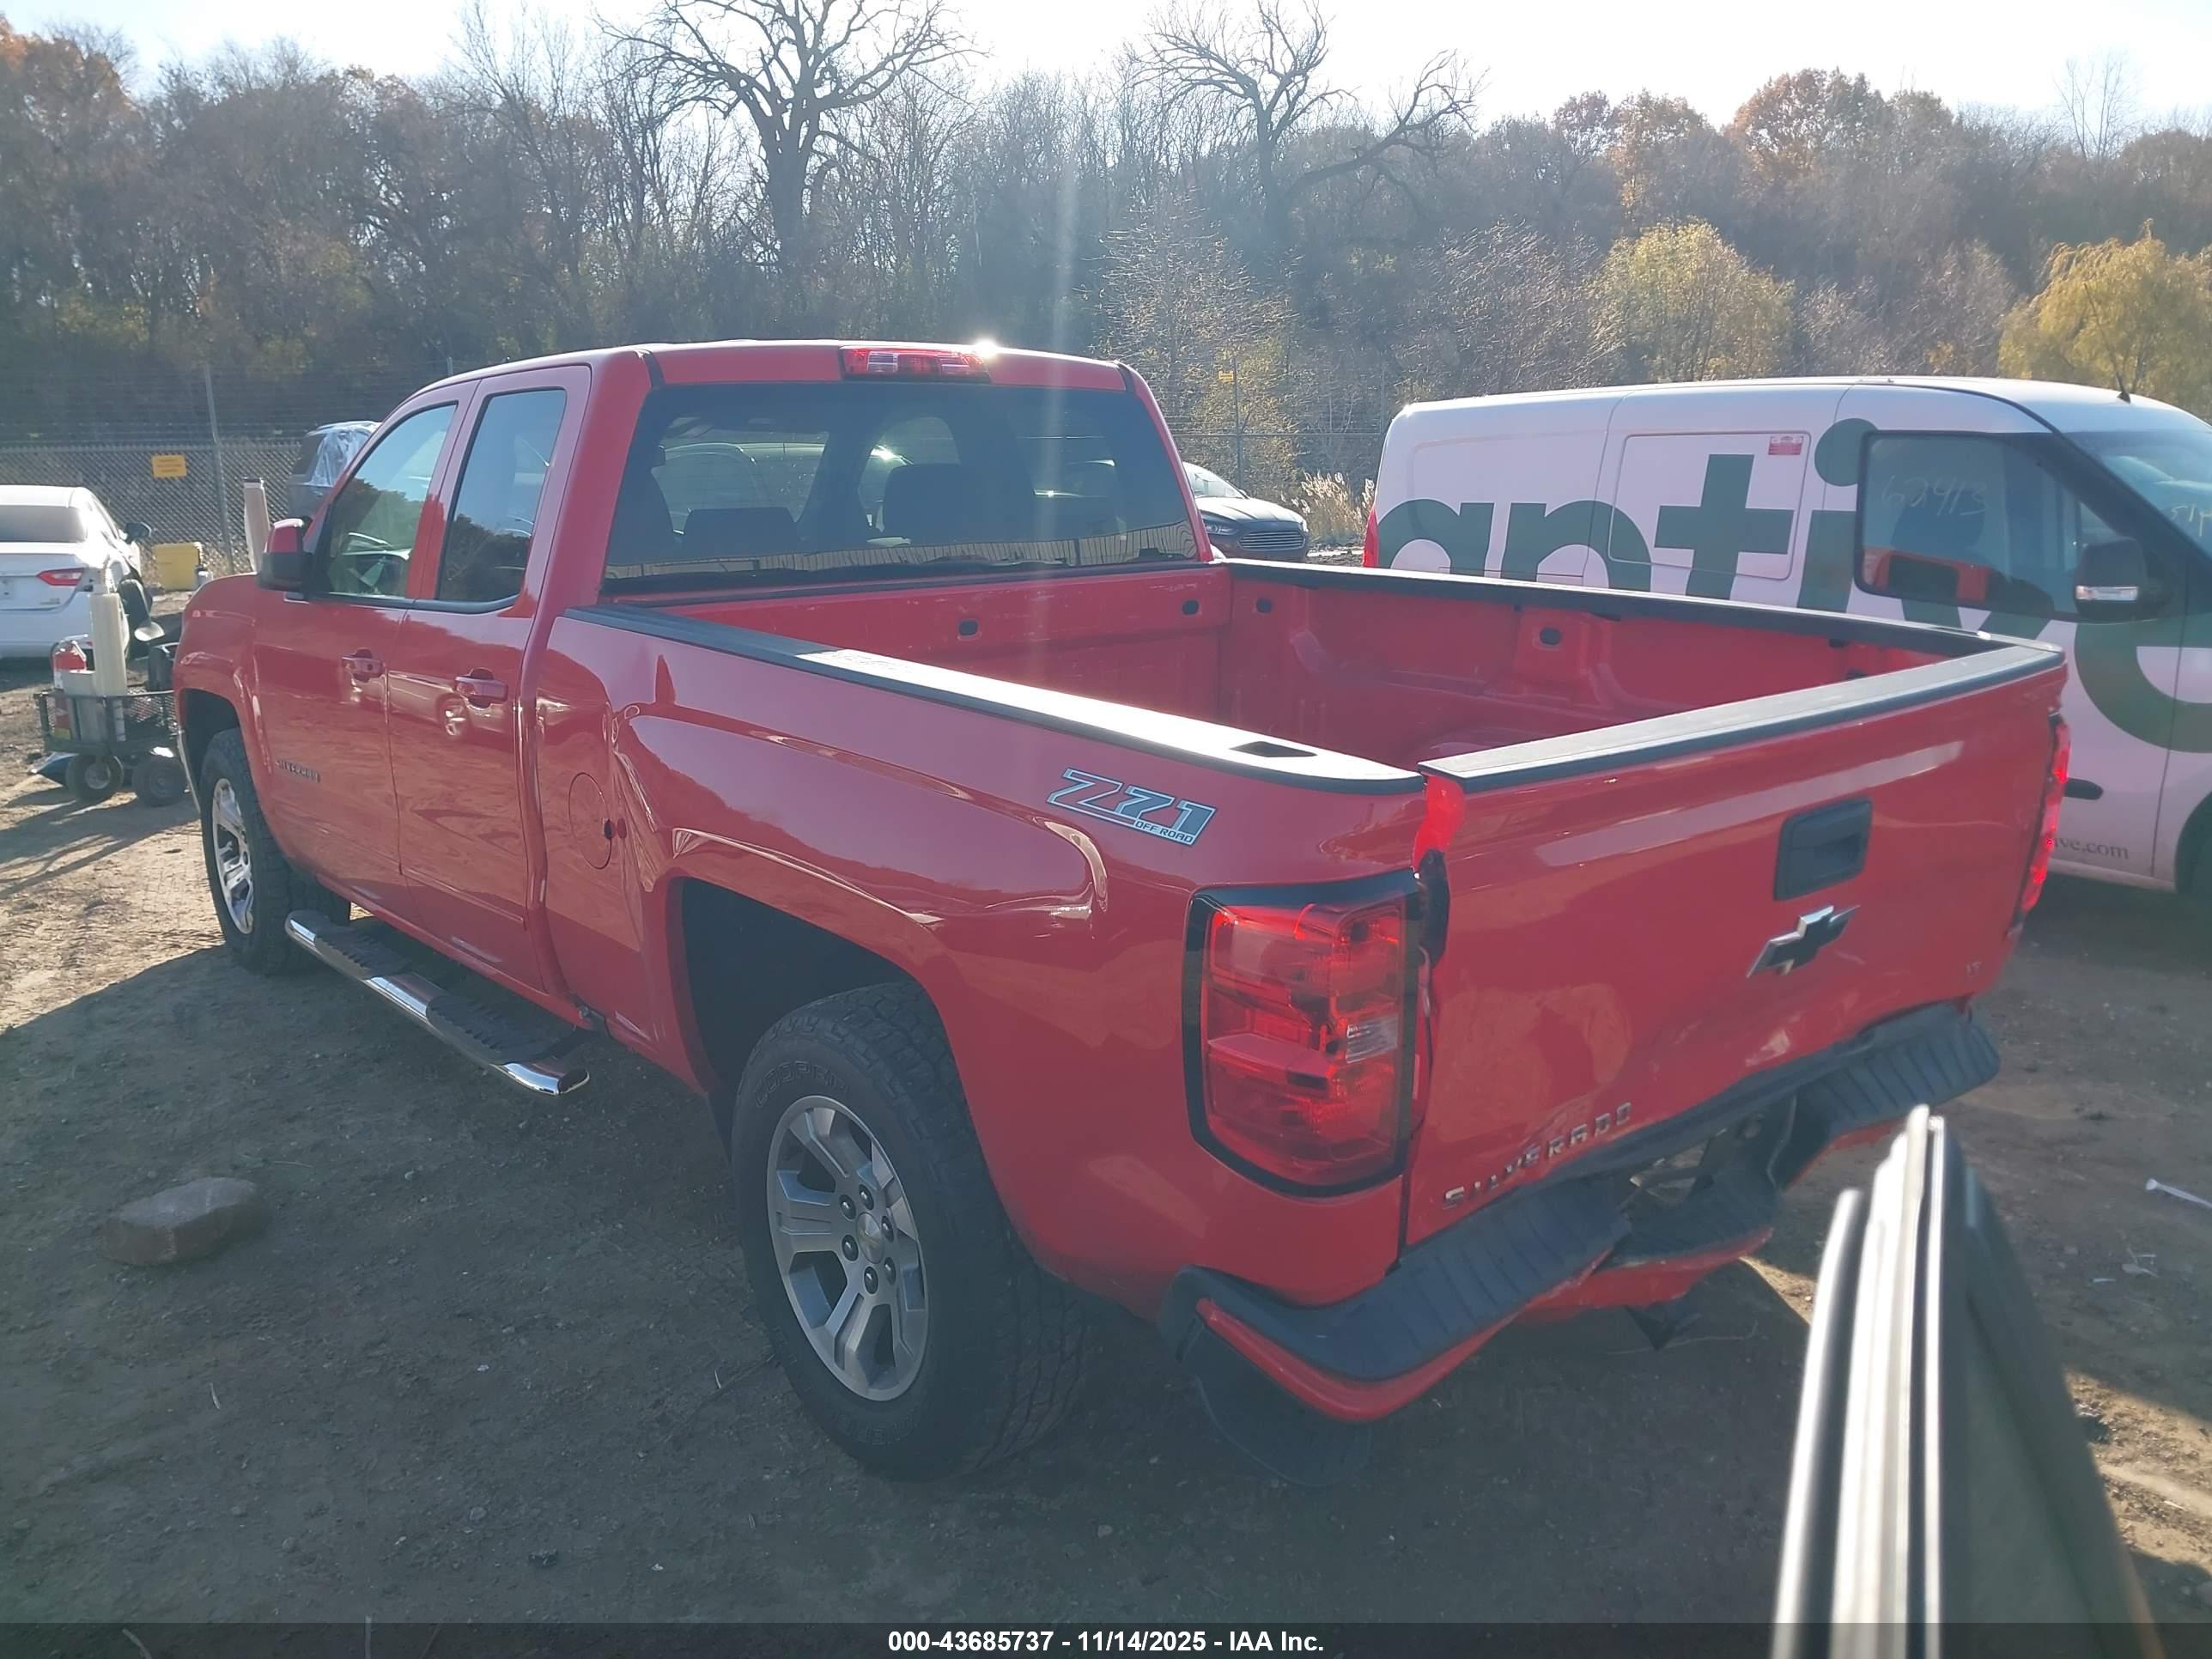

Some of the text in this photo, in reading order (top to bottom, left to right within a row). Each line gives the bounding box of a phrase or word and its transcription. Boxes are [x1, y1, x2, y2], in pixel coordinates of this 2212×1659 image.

[1046, 768, 1216, 842] Z71
[1135, 820, 1194, 842] OFF ROAD
